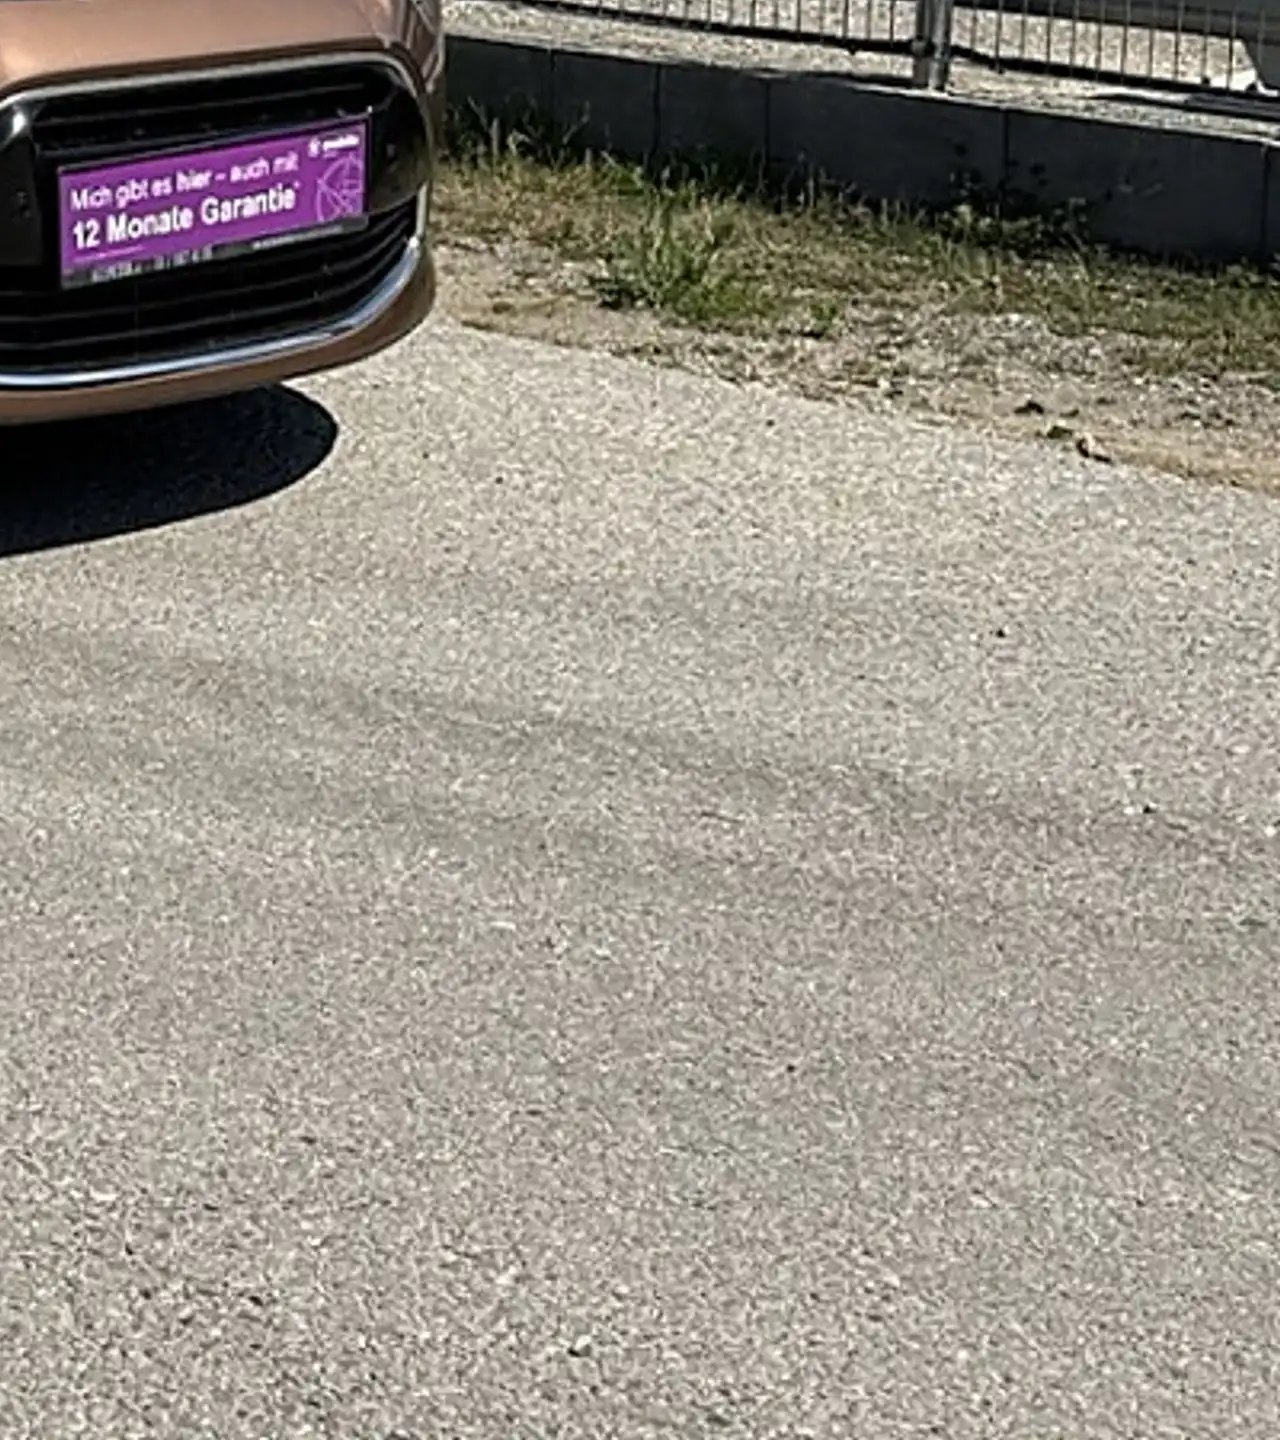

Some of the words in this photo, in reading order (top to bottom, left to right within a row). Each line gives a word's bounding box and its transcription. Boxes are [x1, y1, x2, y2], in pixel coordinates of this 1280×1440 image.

[70, 185, 114, 212] Mich
[115, 177, 149, 210] gibt
[151, 175, 173, 197] es
[176, 168, 212, 193] hier
[230, 157, 271, 183] auch
[272, 150, 299, 174] mit
[73, 217, 101, 250] 12
[106, 205, 194, 245] Monate
